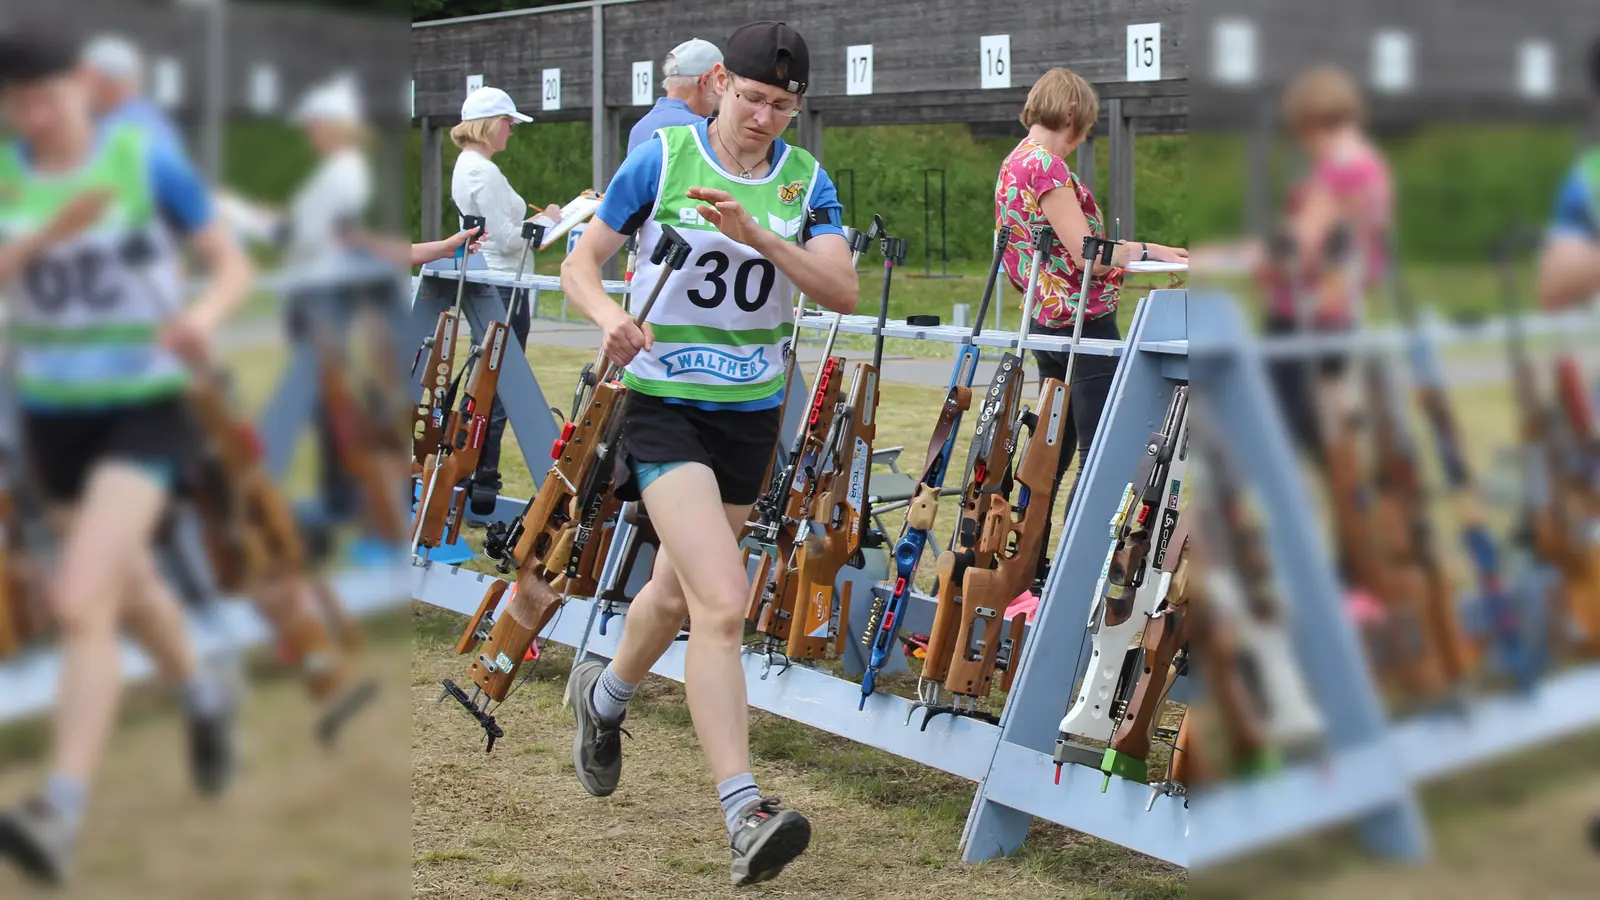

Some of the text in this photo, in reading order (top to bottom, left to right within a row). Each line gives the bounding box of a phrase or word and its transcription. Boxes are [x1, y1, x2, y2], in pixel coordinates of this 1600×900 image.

[986, 48, 1005, 76] 16
[1133, 36, 1154, 68] 15
[636, 71, 649, 97] 19
[852, 56, 867, 84] 17
[545, 78, 558, 101] 20
[687, 251, 775, 312] 30
[677, 353, 757, 377] WALTHER
